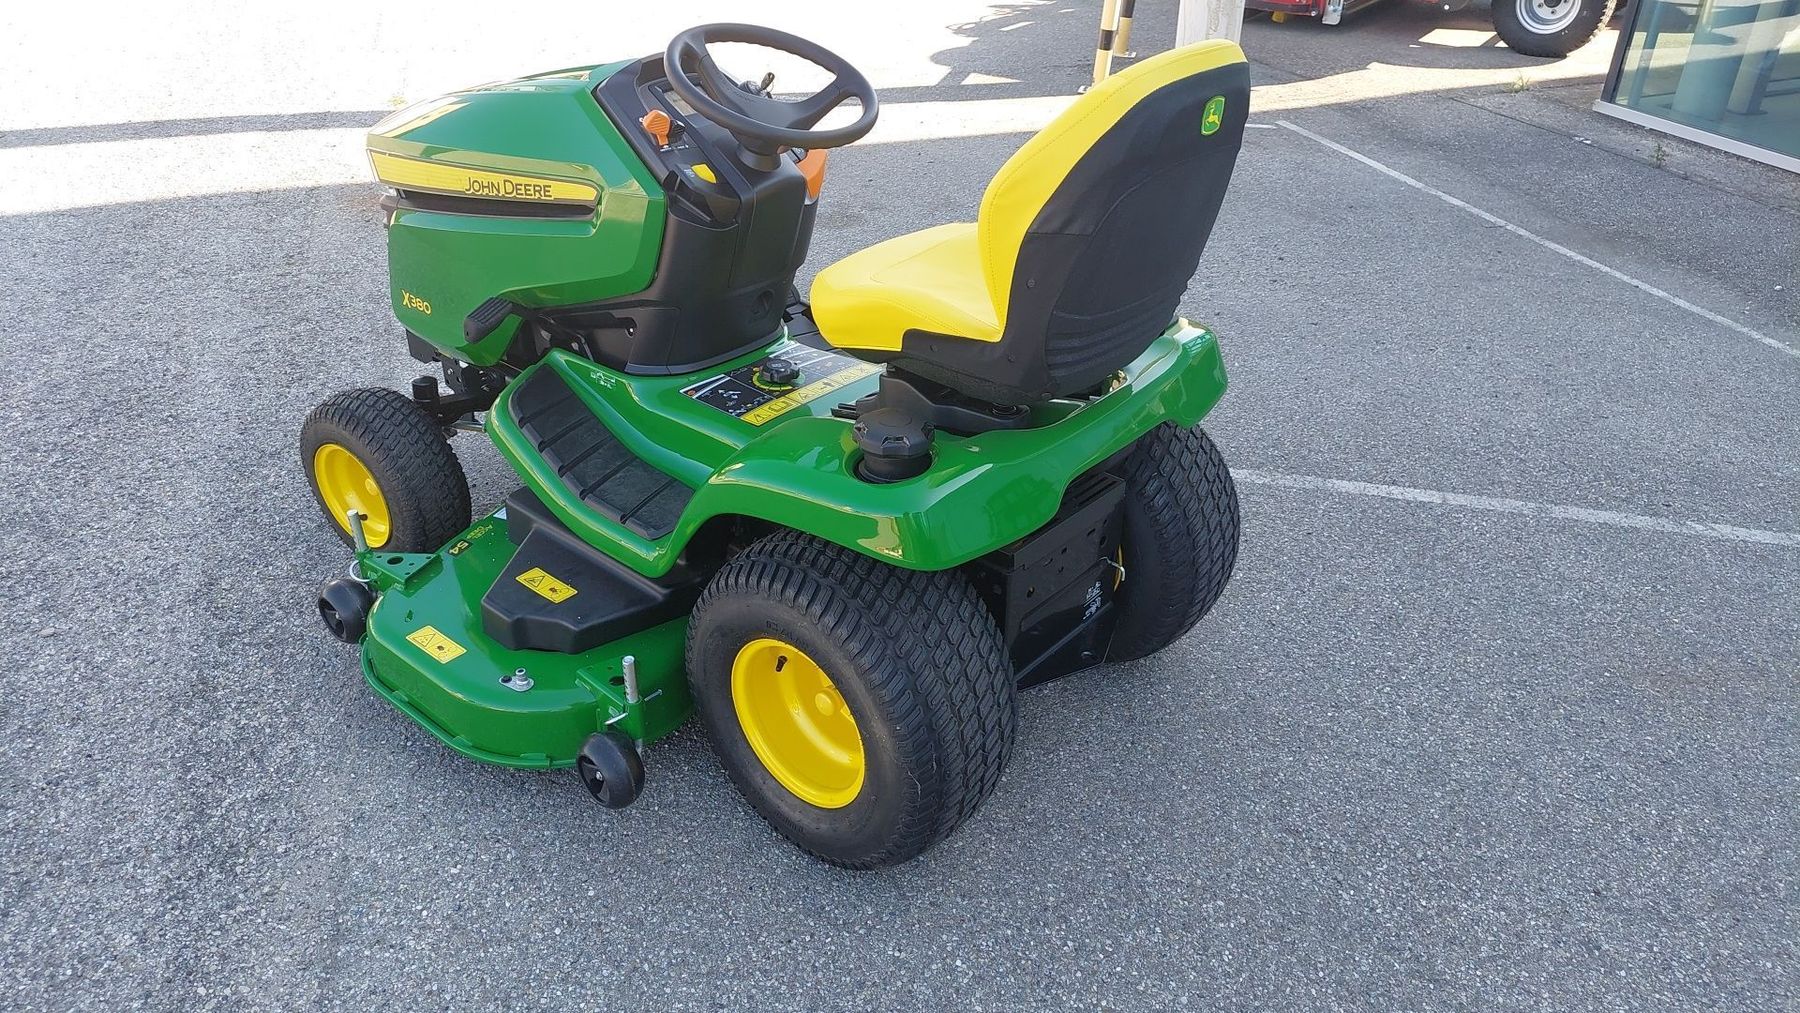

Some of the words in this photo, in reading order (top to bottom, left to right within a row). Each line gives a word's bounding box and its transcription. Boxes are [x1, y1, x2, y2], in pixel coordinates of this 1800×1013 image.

[464, 176, 501, 195] JOHN
[502, 179, 553, 198] DEERE
[401, 289, 432, 315] X380
[448, 540, 470, 555] 54
